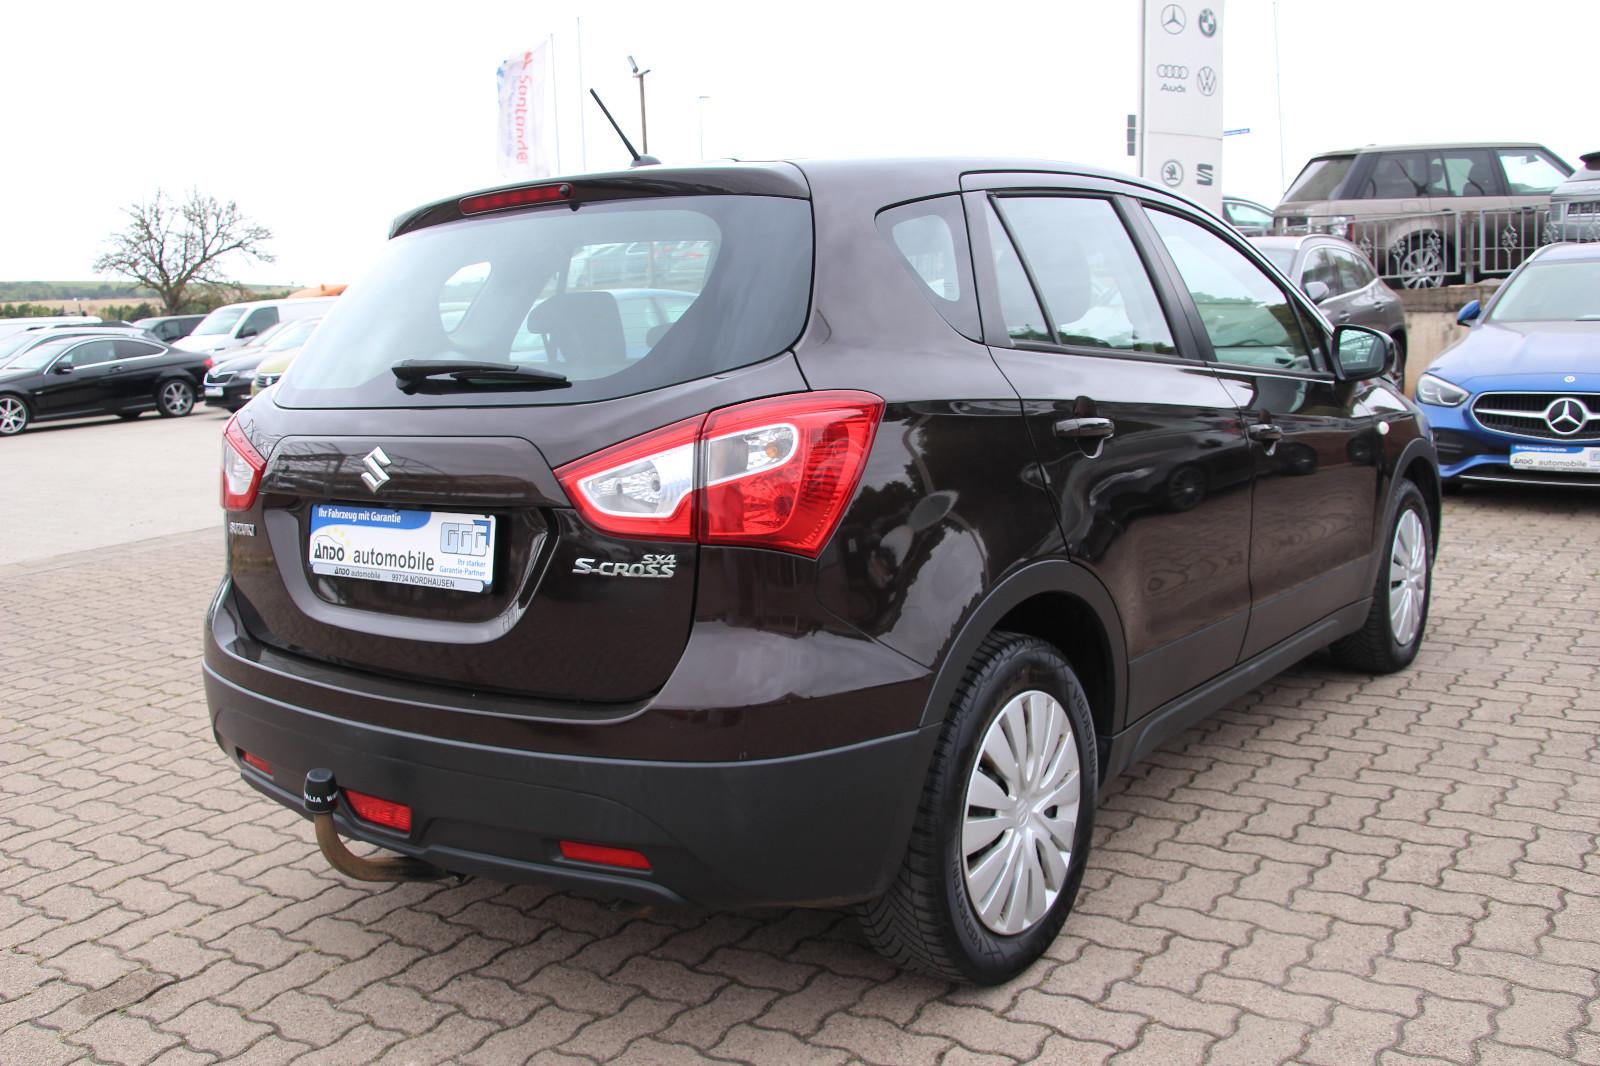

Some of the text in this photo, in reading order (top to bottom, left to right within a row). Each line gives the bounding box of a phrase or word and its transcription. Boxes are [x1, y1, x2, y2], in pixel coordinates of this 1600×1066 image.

[1160, 82, 1186, 93] Audi
[318, 507, 401, 523] Ihr Fahrzeug mit Garantie
[353, 547, 435, 572] automobile
[466, 559, 486, 567] starker
[641, 554, 677, 566] SX4
[440, 565, 486, 577] Garantie-Partner
[572, 557, 677, 578] S-CROSS
[351, 569, 381, 579] automobile
[391, 573, 410, 583] 99734
[410, 575, 456, 589] NORDHAUSEN
